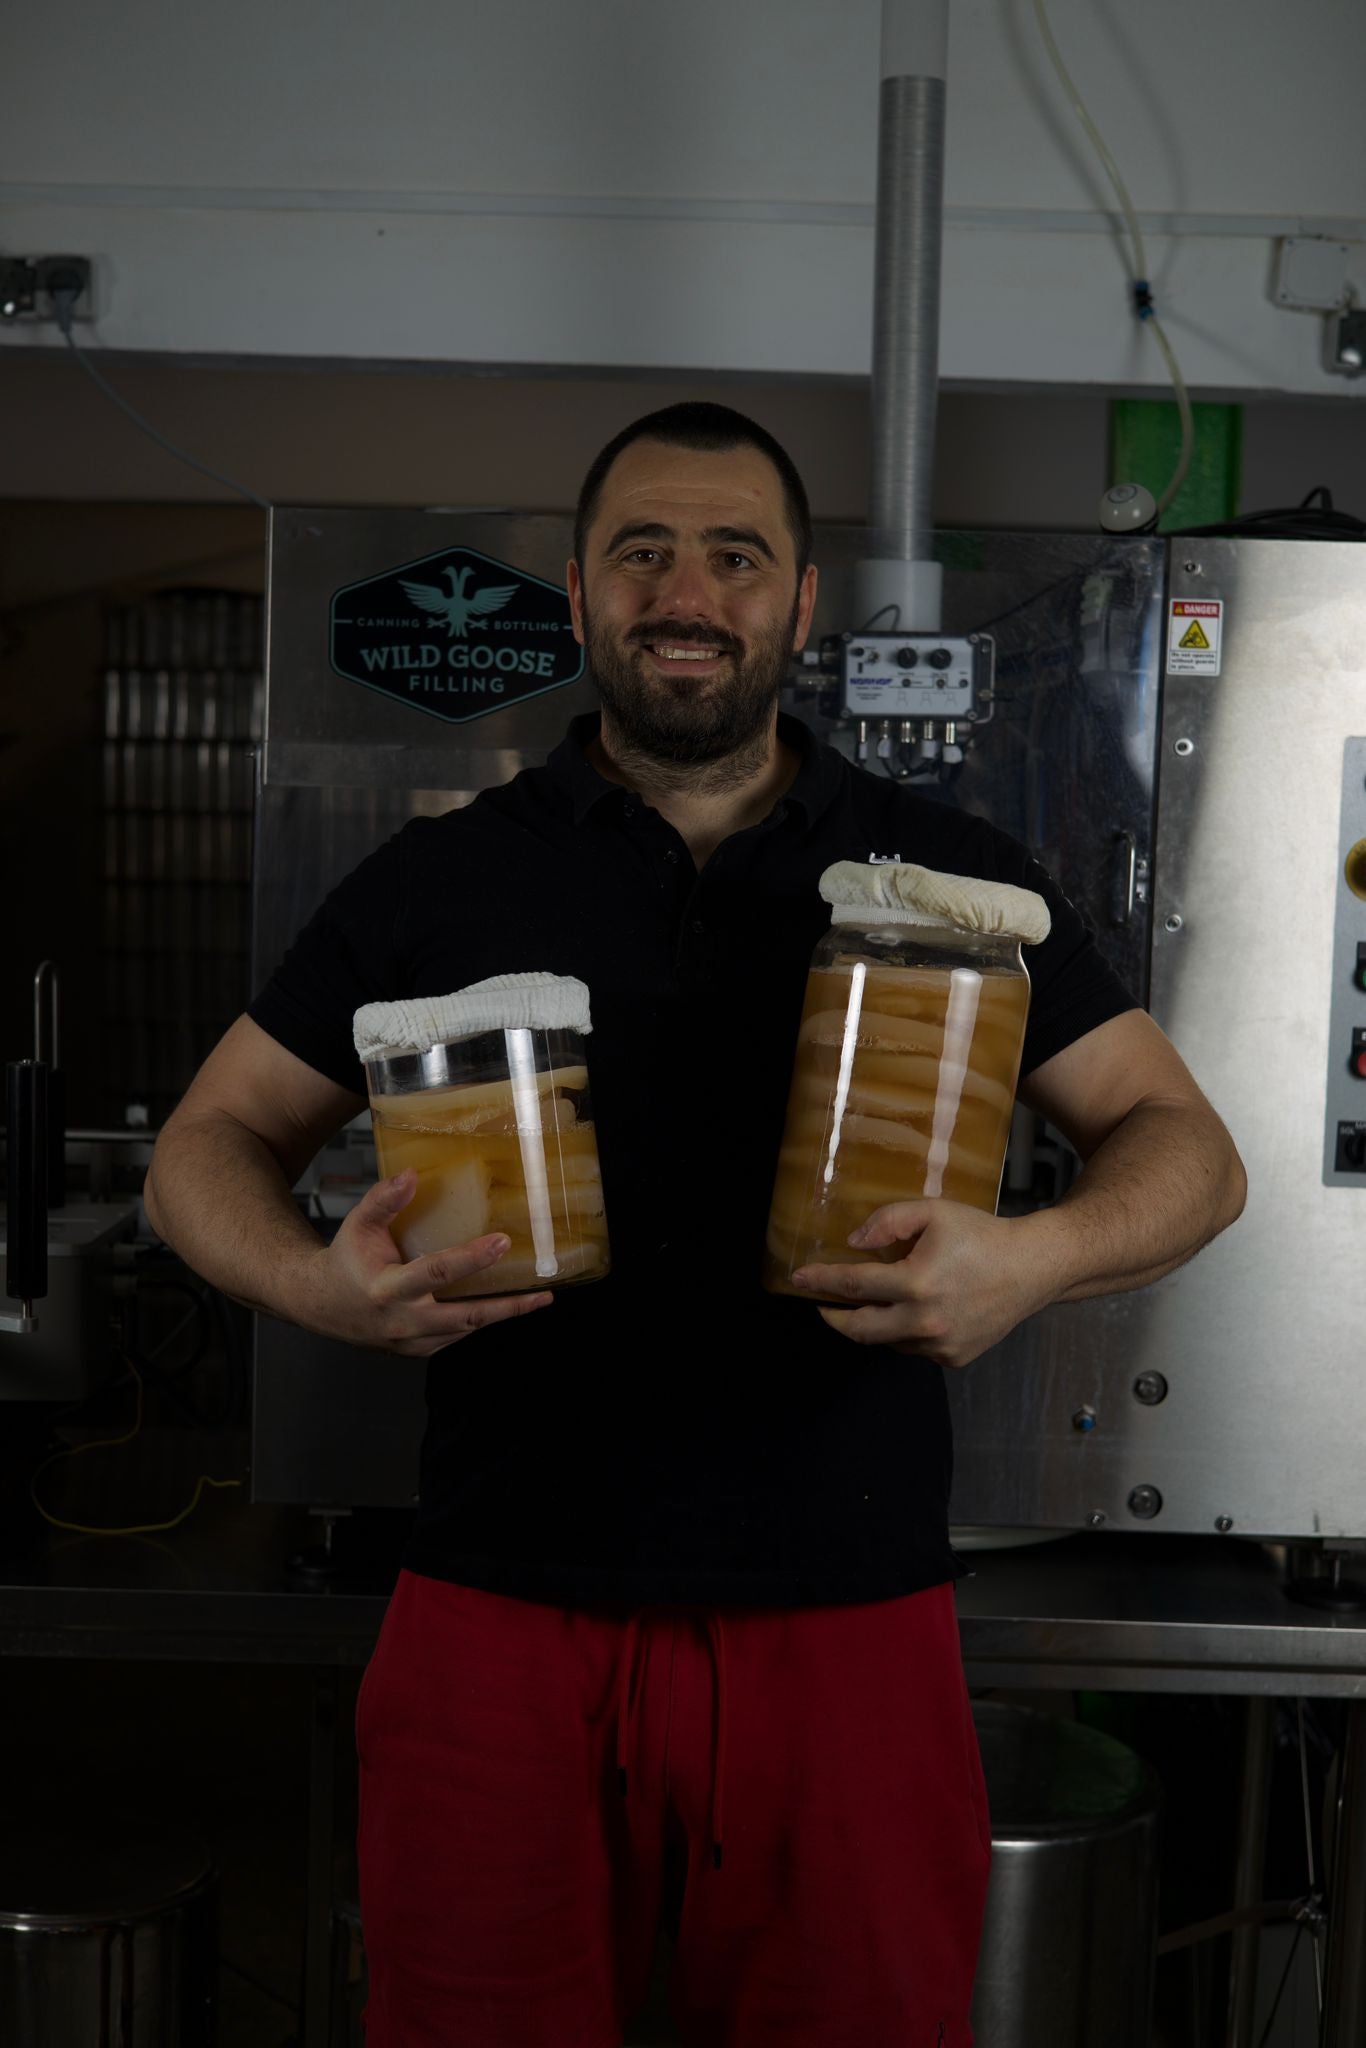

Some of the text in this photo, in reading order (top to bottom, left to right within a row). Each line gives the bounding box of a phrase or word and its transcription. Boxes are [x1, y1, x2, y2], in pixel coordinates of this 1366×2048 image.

[1184, 604, 1218, 615] DANGER
[355, 616, 560, 632] CANNING BOTTLING
[358, 643, 557, 678] WILD GOOSE
[408, 674, 506, 694] FILLING
